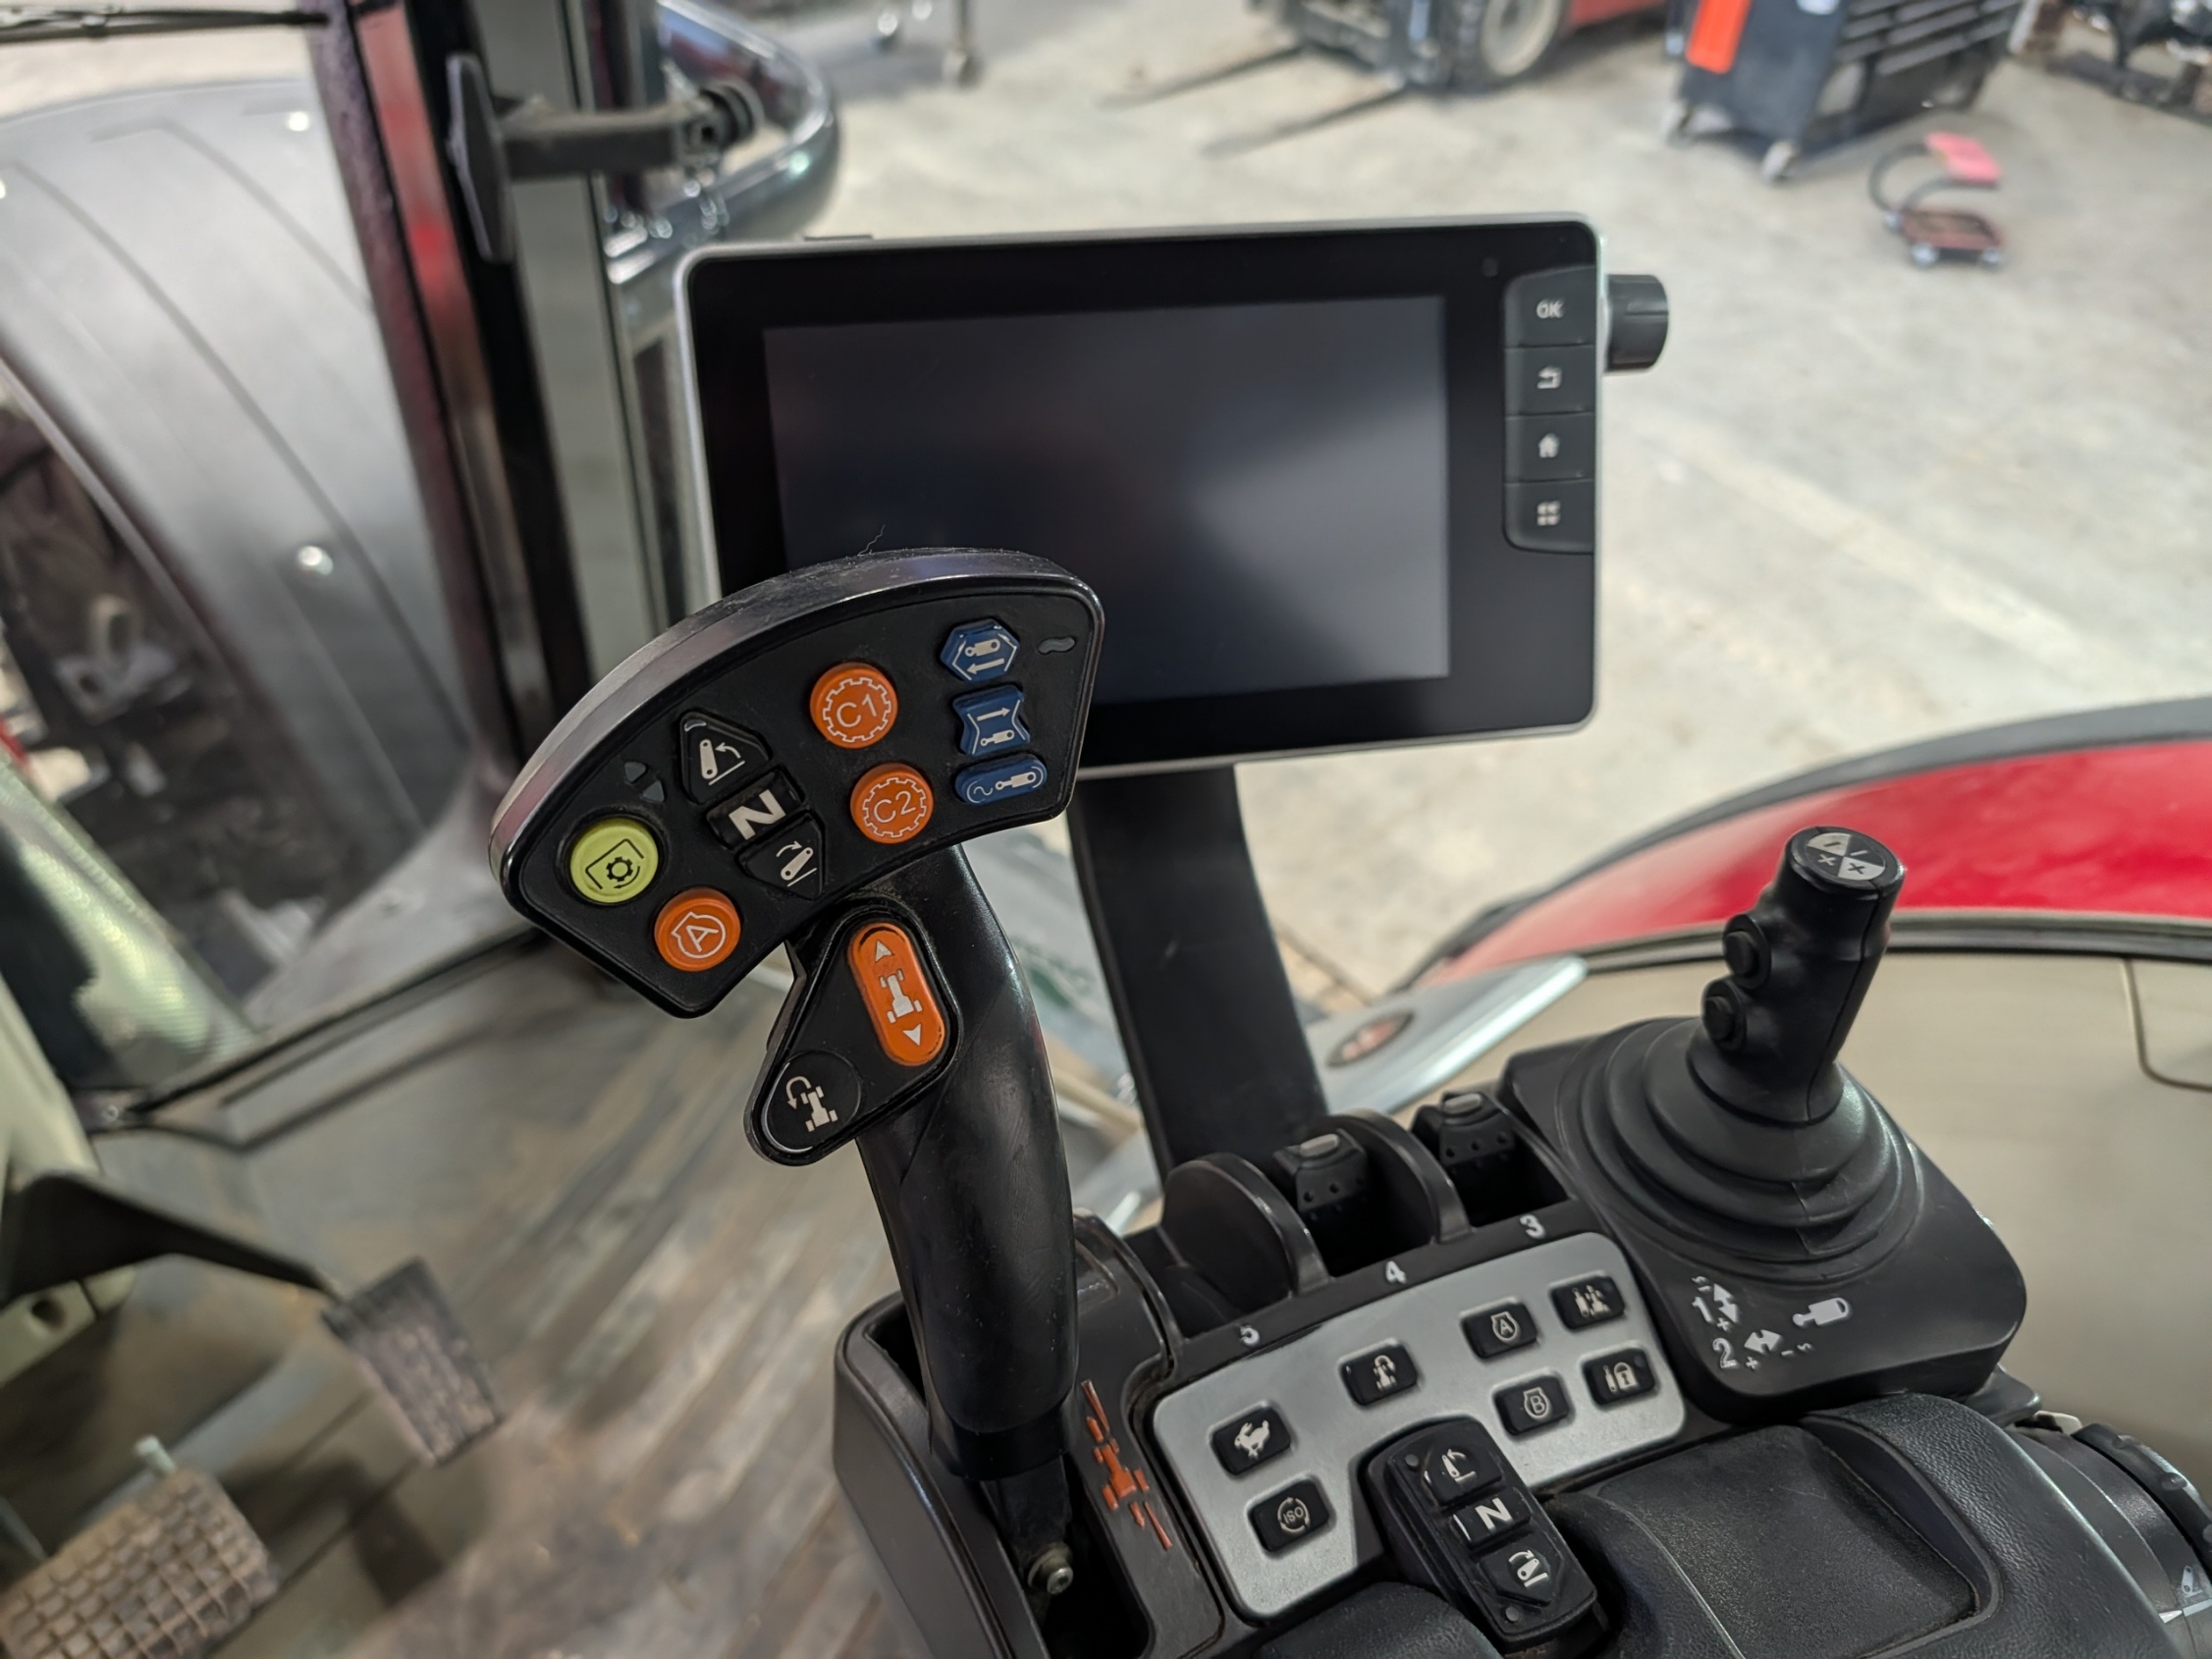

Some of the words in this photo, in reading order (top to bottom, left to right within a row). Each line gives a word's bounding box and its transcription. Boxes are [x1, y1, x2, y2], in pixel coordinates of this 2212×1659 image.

[1537, 297, 1565, 319] OK
[835, 696, 876, 728] C1
[728, 788, 787, 838] N
[873, 791, 915, 824] C2
[689, 918, 721, 950] A
[1519, 1213, 1546, 1239] 3
[1384, 1260, 1407, 1284] 4
[1692, 1297, 1714, 1323] 1
[1240, 1323, 1261, 1348] 5
[1499, 1319, 1513, 1337] A
[1712, 1338, 1737, 1369] 2
[1528, 1394, 1545, 1416] B
[1282, 1507, 1304, 1525] ISO
[1475, 1497, 1512, 1531] N
